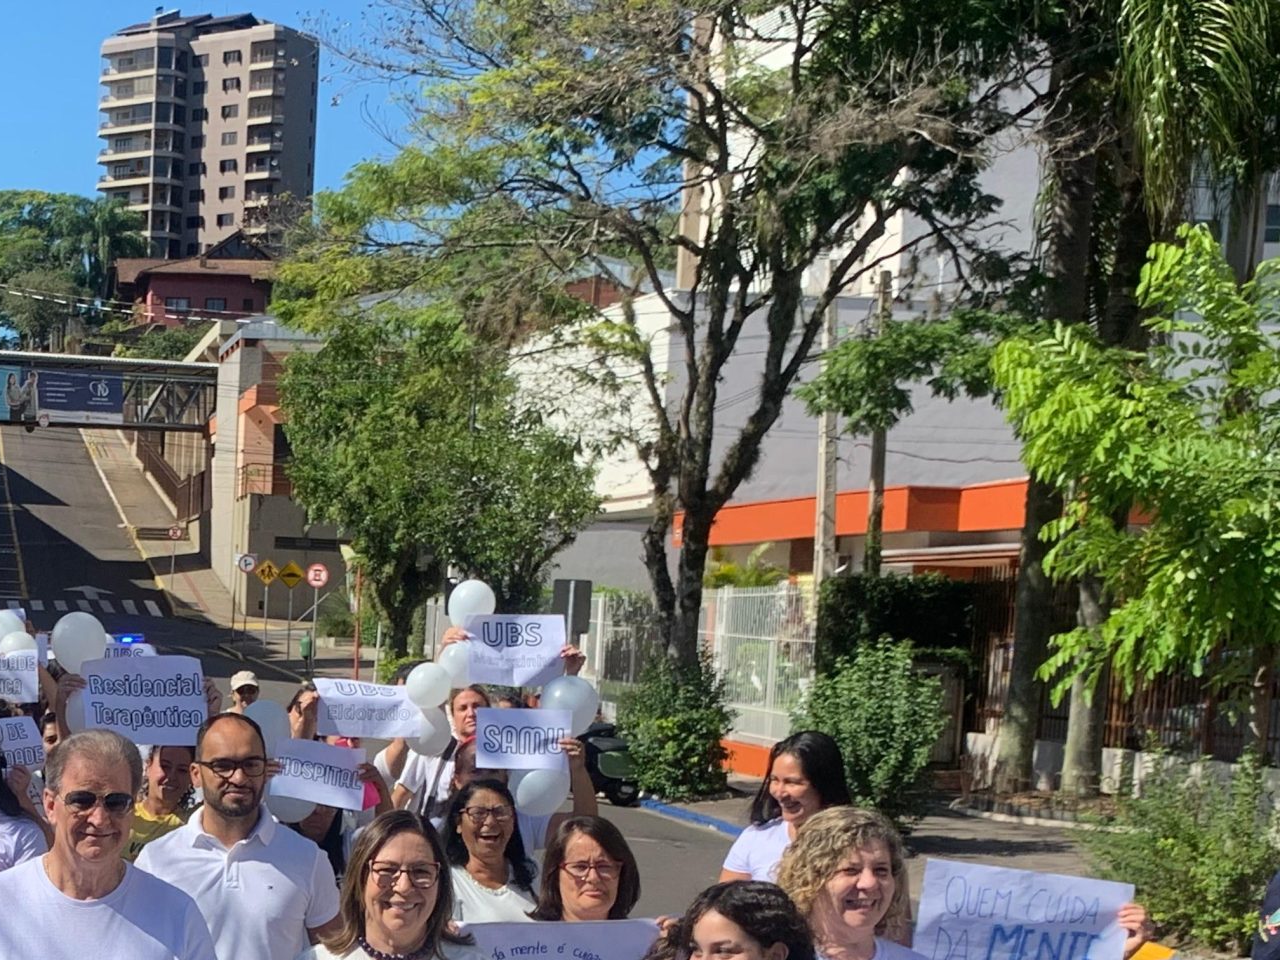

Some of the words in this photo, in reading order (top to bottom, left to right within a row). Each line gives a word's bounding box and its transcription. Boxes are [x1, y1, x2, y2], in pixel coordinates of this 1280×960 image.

[482, 621, 542, 648] UBS
[88, 673, 202, 697] Residencial
[334, 680, 397, 698] UBS
[91, 701, 203, 731] Terapêutico
[327, 703, 412, 722] Eldorado
[6, 721, 29, 741] DE
[483, 723, 564, 755] SAMU
[278, 756, 364, 791] HOSPITAL
[944, 875, 1013, 920] QUEM
[1024, 888, 1100, 925] CUIDA
[510, 941, 549, 957] mente
